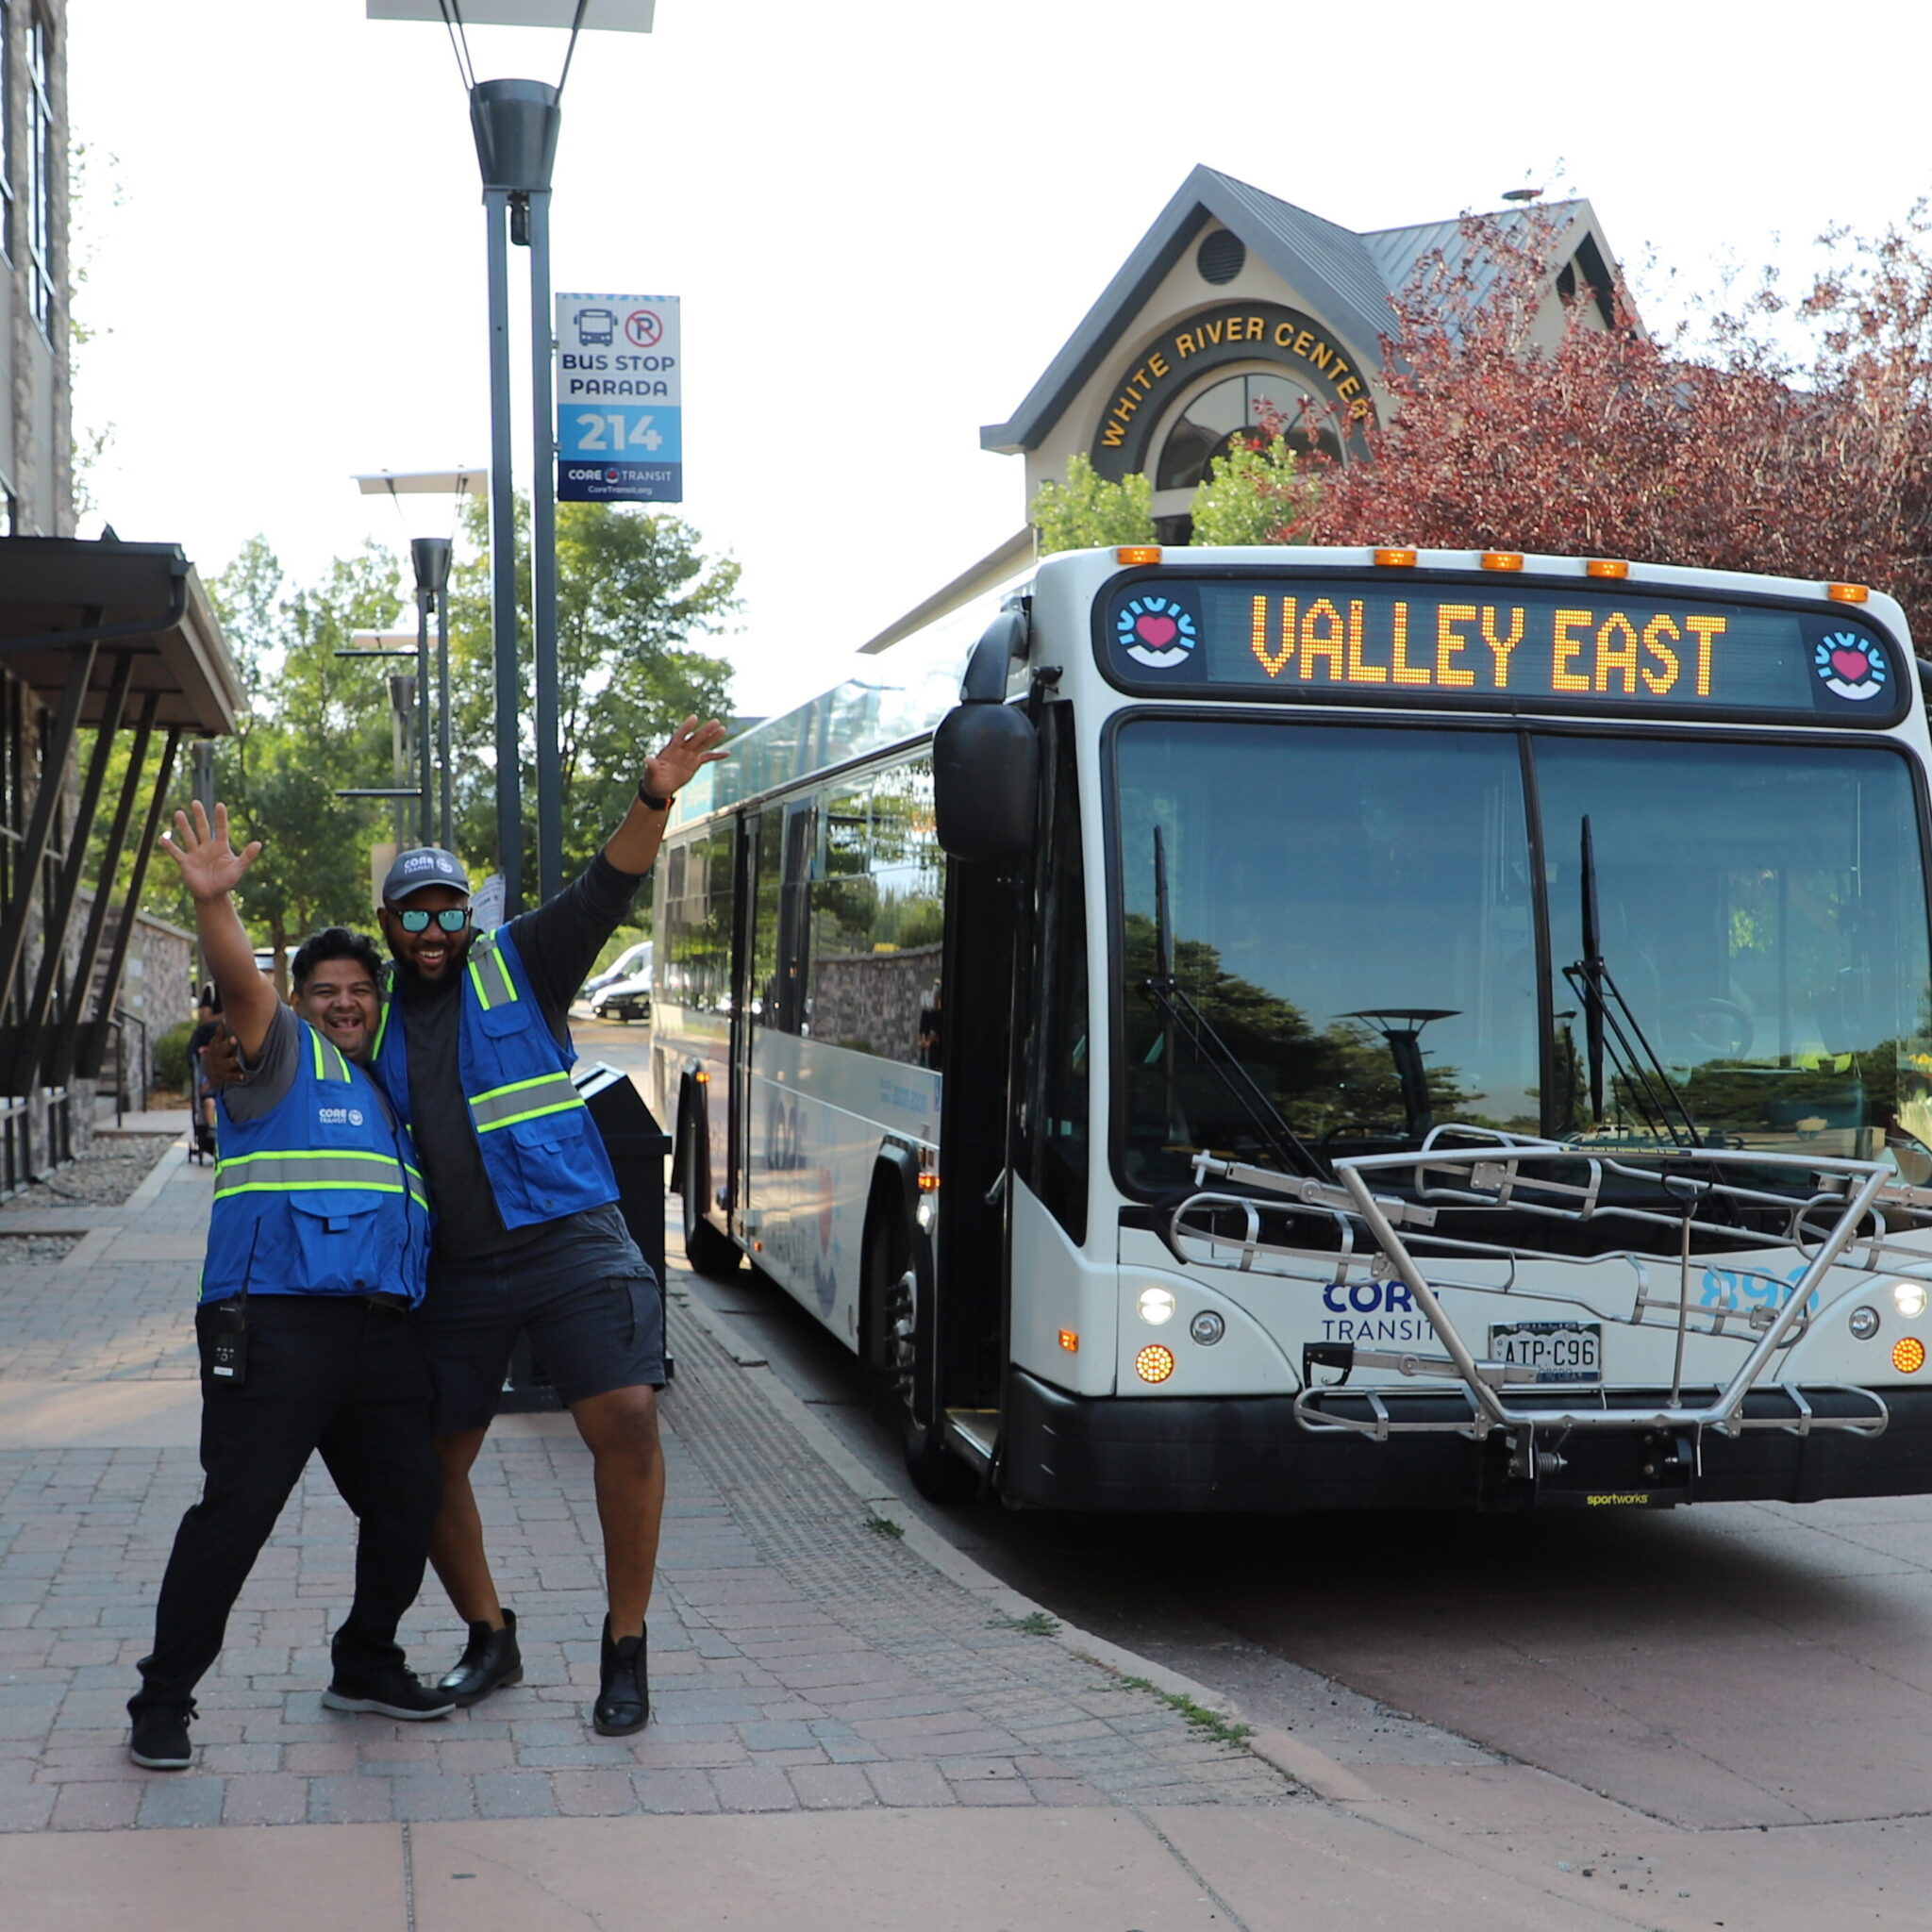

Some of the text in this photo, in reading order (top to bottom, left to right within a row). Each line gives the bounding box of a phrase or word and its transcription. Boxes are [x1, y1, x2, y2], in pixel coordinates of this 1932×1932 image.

[562, 354, 675, 373] BUS STOP
[570, 378, 668, 396] PARADA
[1102, 316, 1369, 447] WHITE RIVER CENTER
[576, 413, 662, 452] 214
[568, 469, 673, 482] CORE TRANSIT
[588, 485, 654, 496] CoreTransit.org
[1252, 594, 1727, 696] VALLEY EAST
[319, 1108, 347, 1118] CORE
[1323, 1280, 1439, 1313] COR
[1587, 1493, 1649, 1507] sportworks
